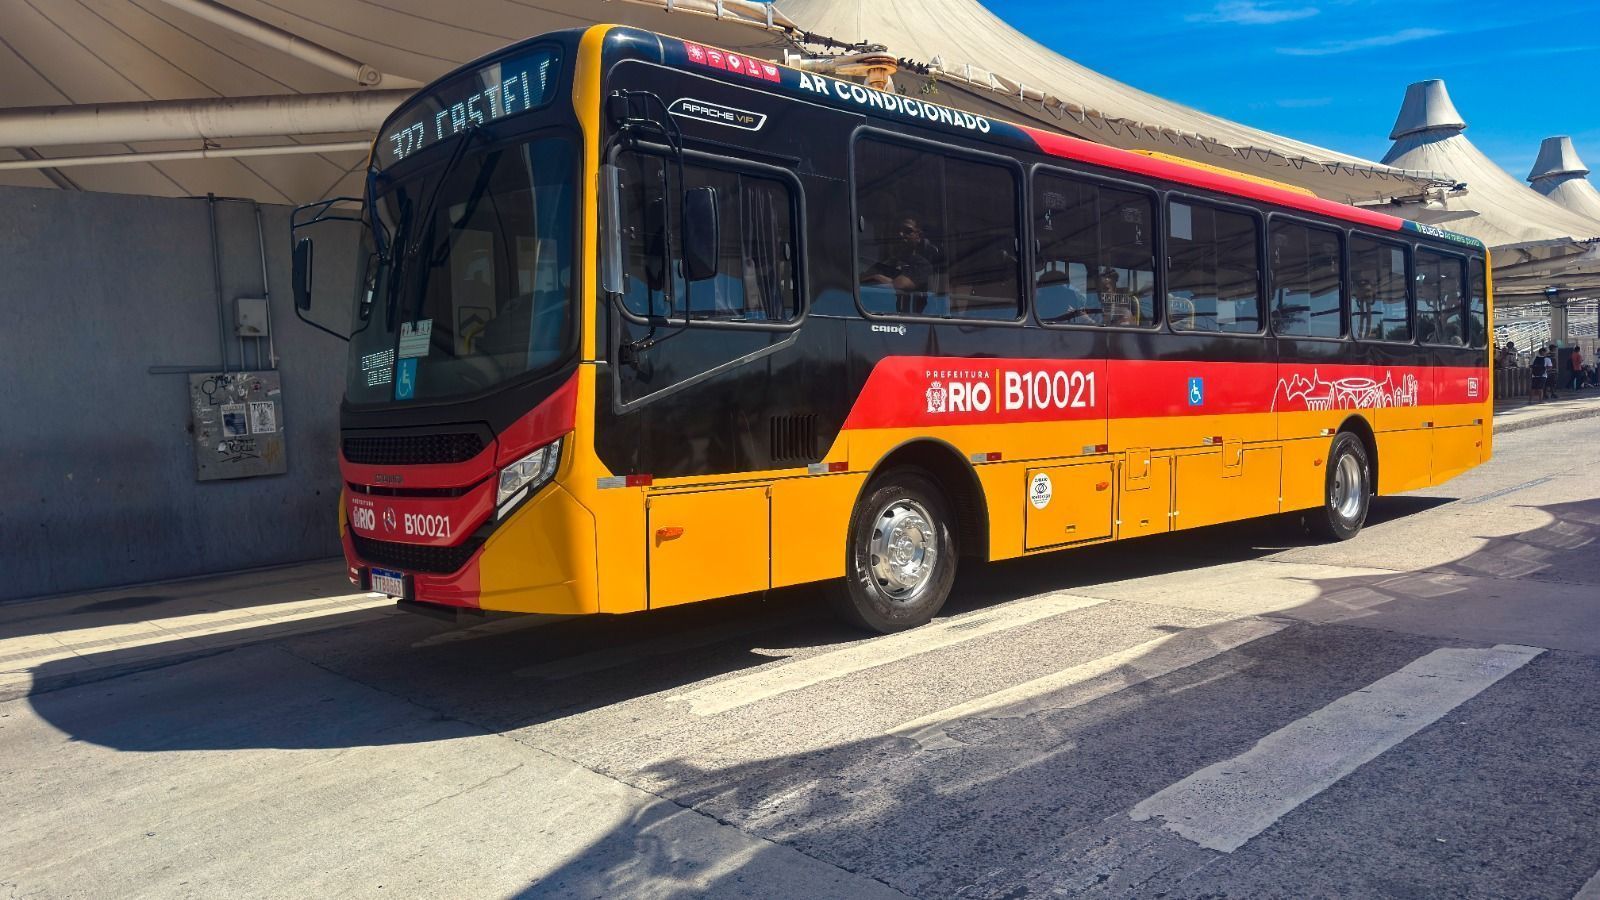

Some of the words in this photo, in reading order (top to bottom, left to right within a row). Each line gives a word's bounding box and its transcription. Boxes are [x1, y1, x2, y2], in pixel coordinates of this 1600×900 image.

[682, 102, 734, 121] APACHE
[735, 114, 754, 124] VIP
[799, 72, 830, 96] AR
[839, 80, 991, 134] CONDICIONADO
[926, 370, 990, 379] PREFEITURA
[949, 382, 991, 412] RIO
[1005, 370, 1095, 410] B10021
[359, 508, 376, 531] RIO
[404, 513, 451, 538] B10021
